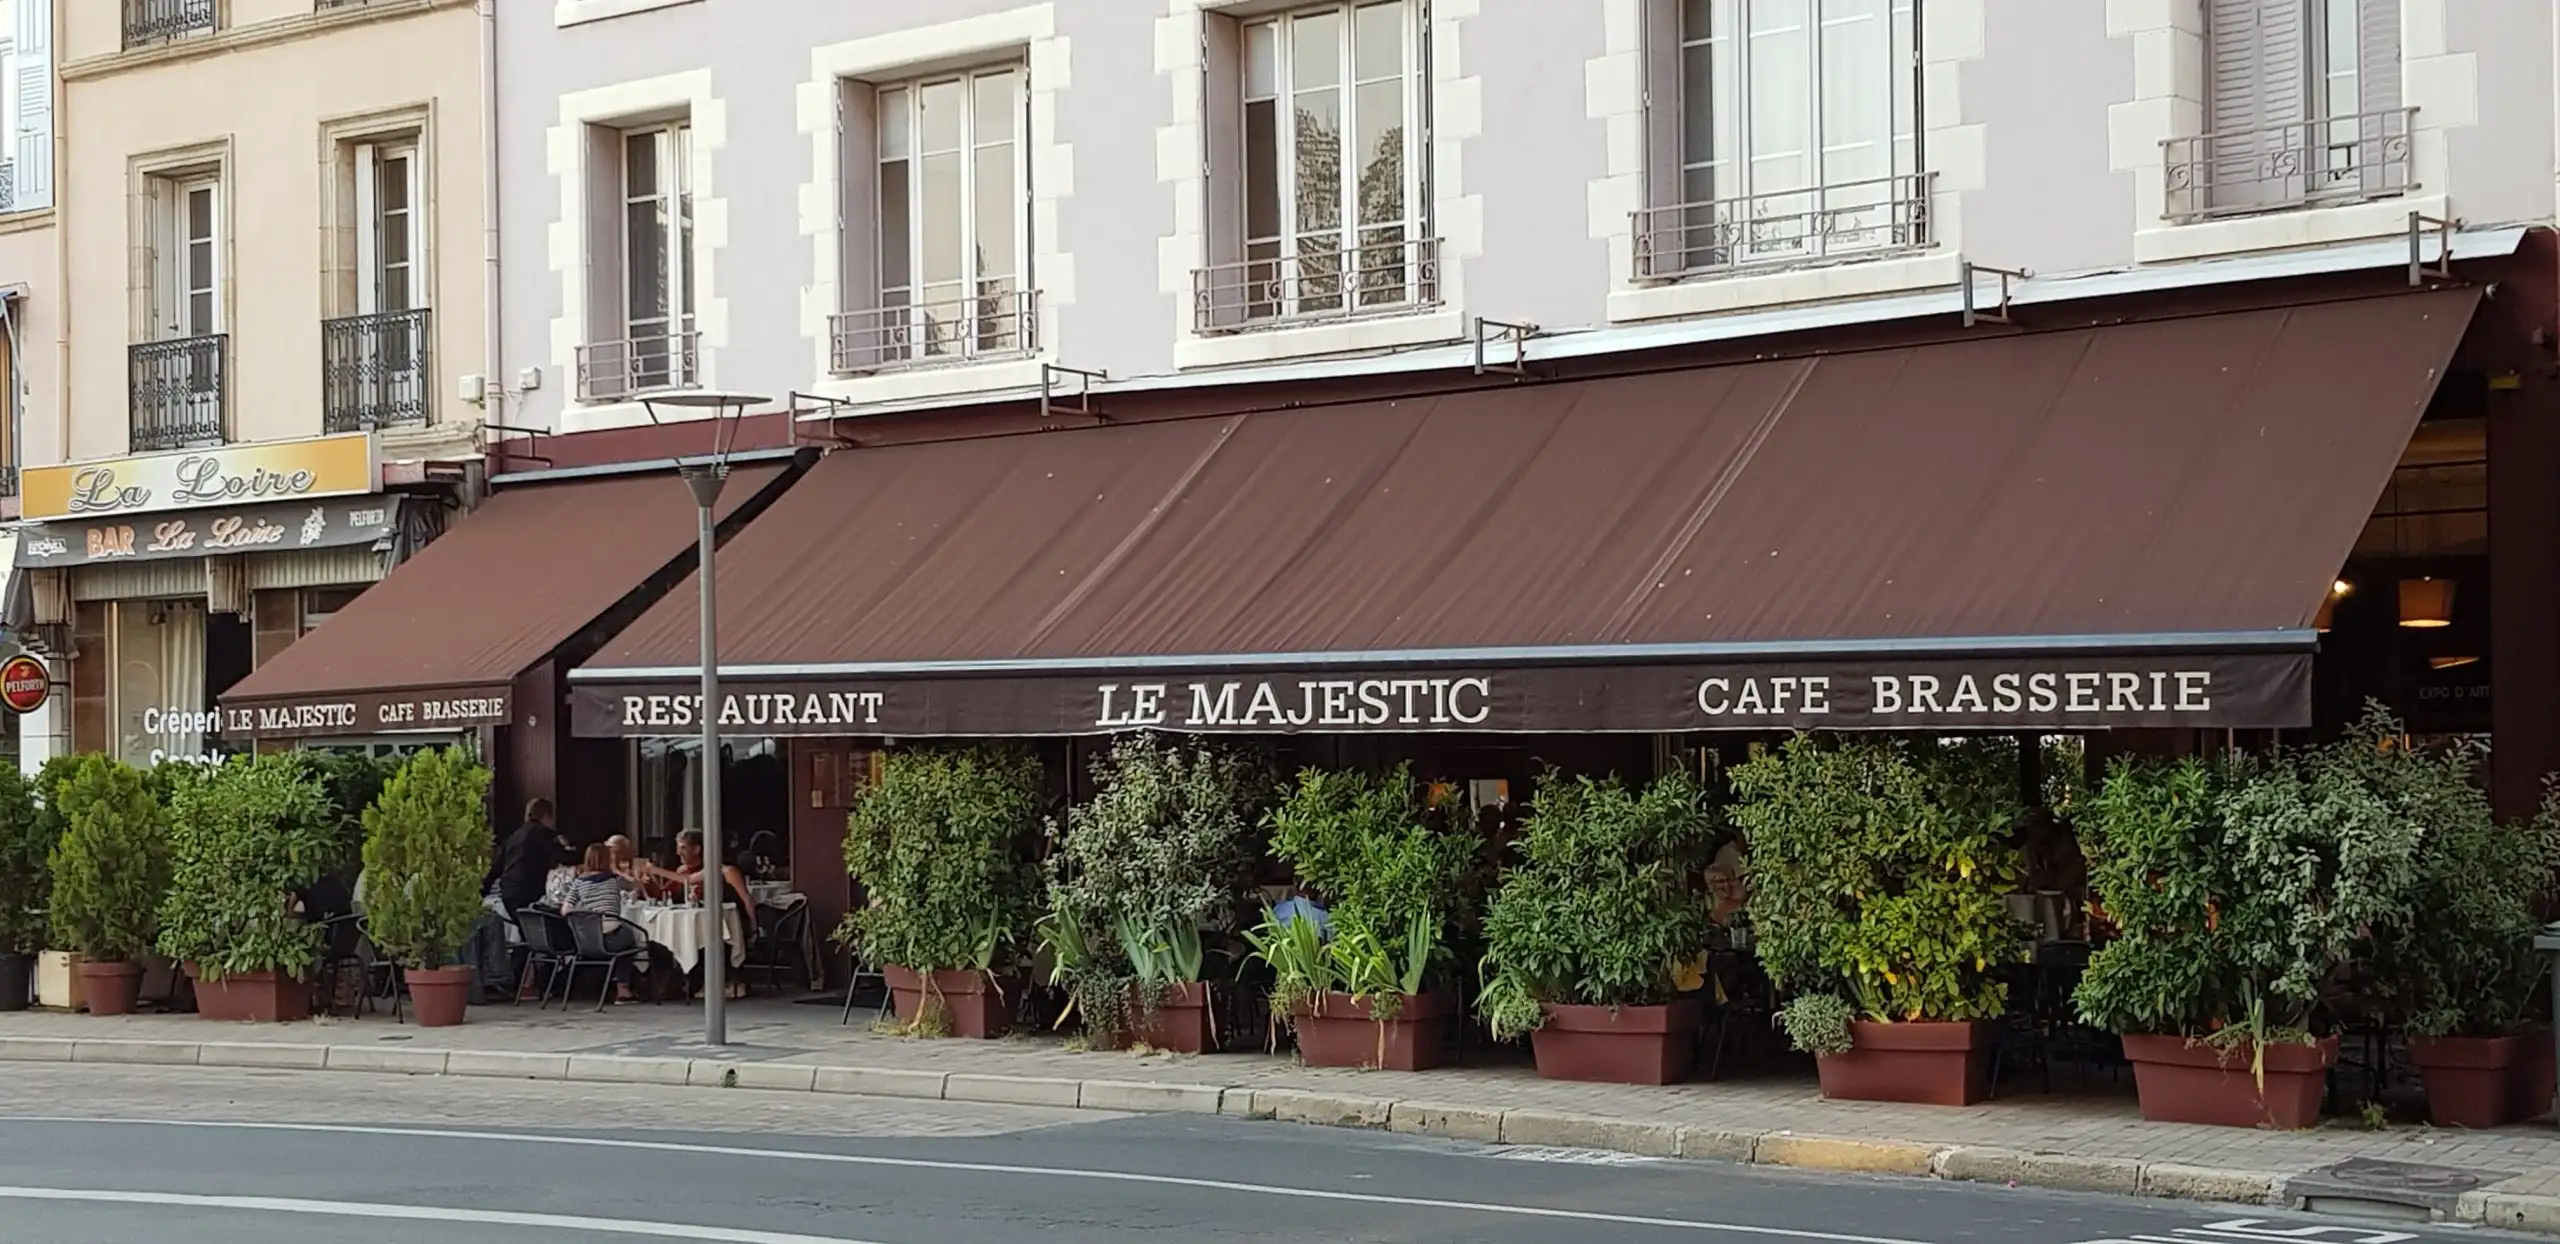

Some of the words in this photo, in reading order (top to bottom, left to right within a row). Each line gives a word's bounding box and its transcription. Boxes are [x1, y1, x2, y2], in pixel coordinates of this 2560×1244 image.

[69, 466, 152, 512] La
[171, 456, 316, 503] Loire
[87, 525, 136, 558] BAR
[147, 519, 197, 551] La
[203, 515, 285, 548] Loire
[5, 678, 46, 693] PELFORTH
[1095, 683, 1167, 726] LE
[1184, 677, 1490, 726] MAJESTIC
[1698, 676, 1831, 716] CAFE
[1871, 671, 2211, 714] BRASSERIE
[2419, 686, 2450, 699] EXPO
[144, 705, 223, 740] Crêperi
[228, 709, 253, 731] LE
[259, 703, 356, 730] MAJESTIC
[378, 703, 414, 723] CAFE
[423, 697, 504, 720] BRASSERIE
[622, 692, 883, 725] RESAURANT
